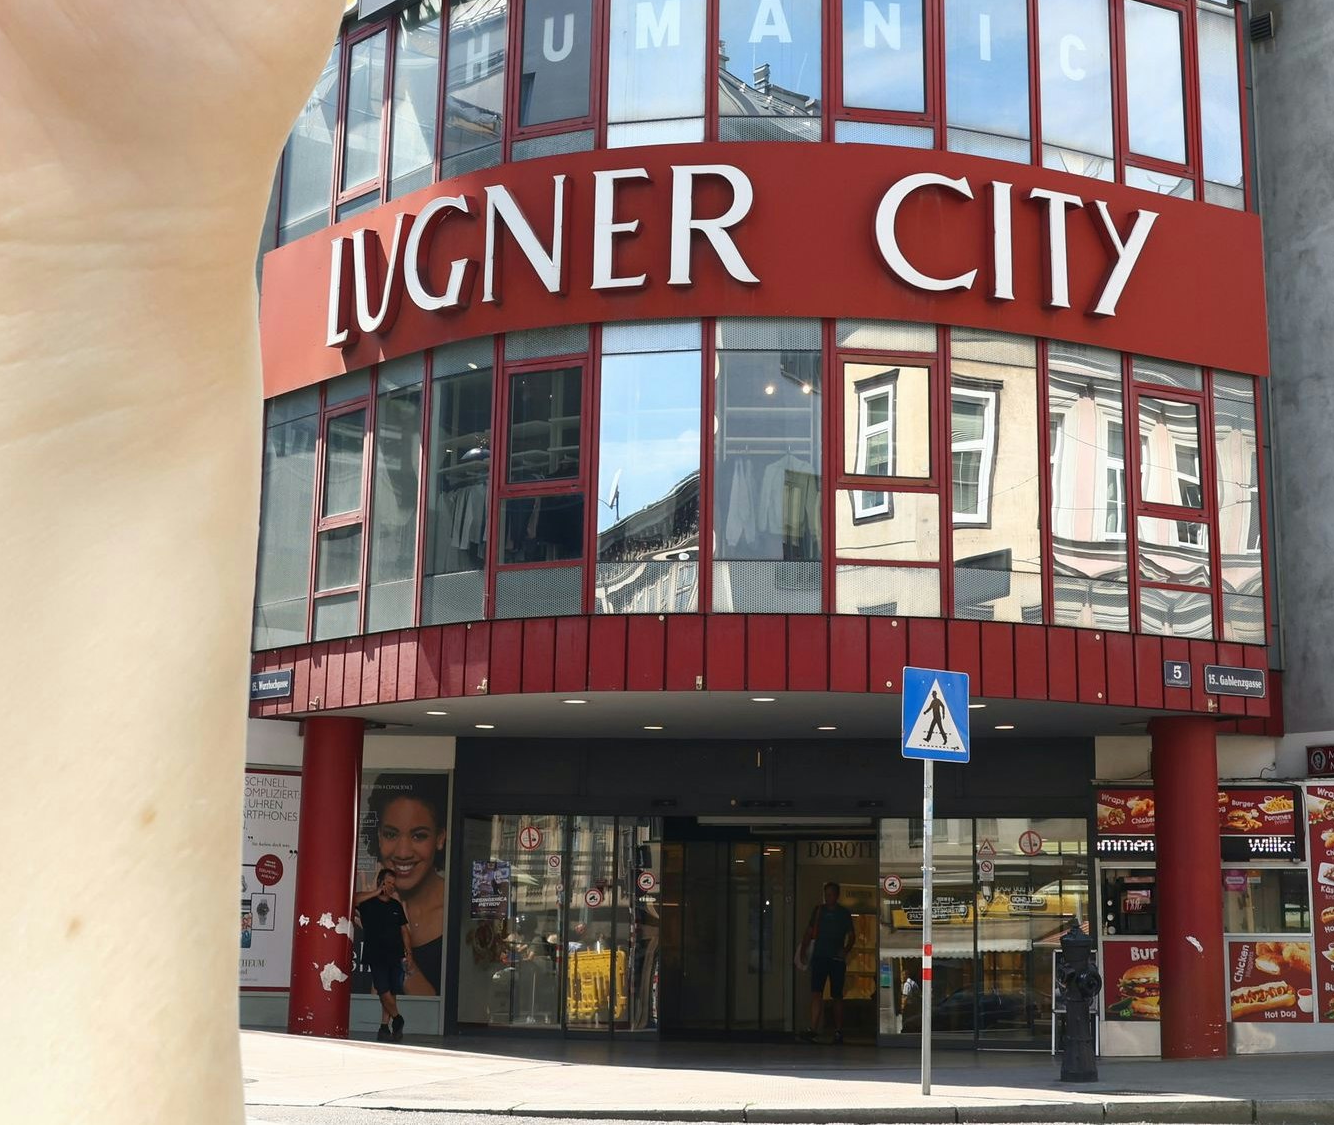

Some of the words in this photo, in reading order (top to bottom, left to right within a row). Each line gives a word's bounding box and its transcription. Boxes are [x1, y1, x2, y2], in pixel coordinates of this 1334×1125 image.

[325, 164, 761, 348] LUGNER
[875, 172, 1160, 317] CITY
[1173, 665, 1182, 679] 5
[1219, 674, 1263, 690] Gablenzgasse
[245, 777, 288, 789] SCHNELL
[244, 788, 301, 800] OMPLIZIERT:
[1101, 792, 1126, 806] Wraps
[248, 799, 284, 810] UHREN
[1231, 799, 1255, 809] Burger
[1264, 813, 1292, 822] Pommes
[1130, 946, 1159, 962] Bur
[1233, 944, 1250, 983] Chicken
[1264, 1011, 1279, 1019] Hot
[1280, 1010, 1297, 1019] Dog
